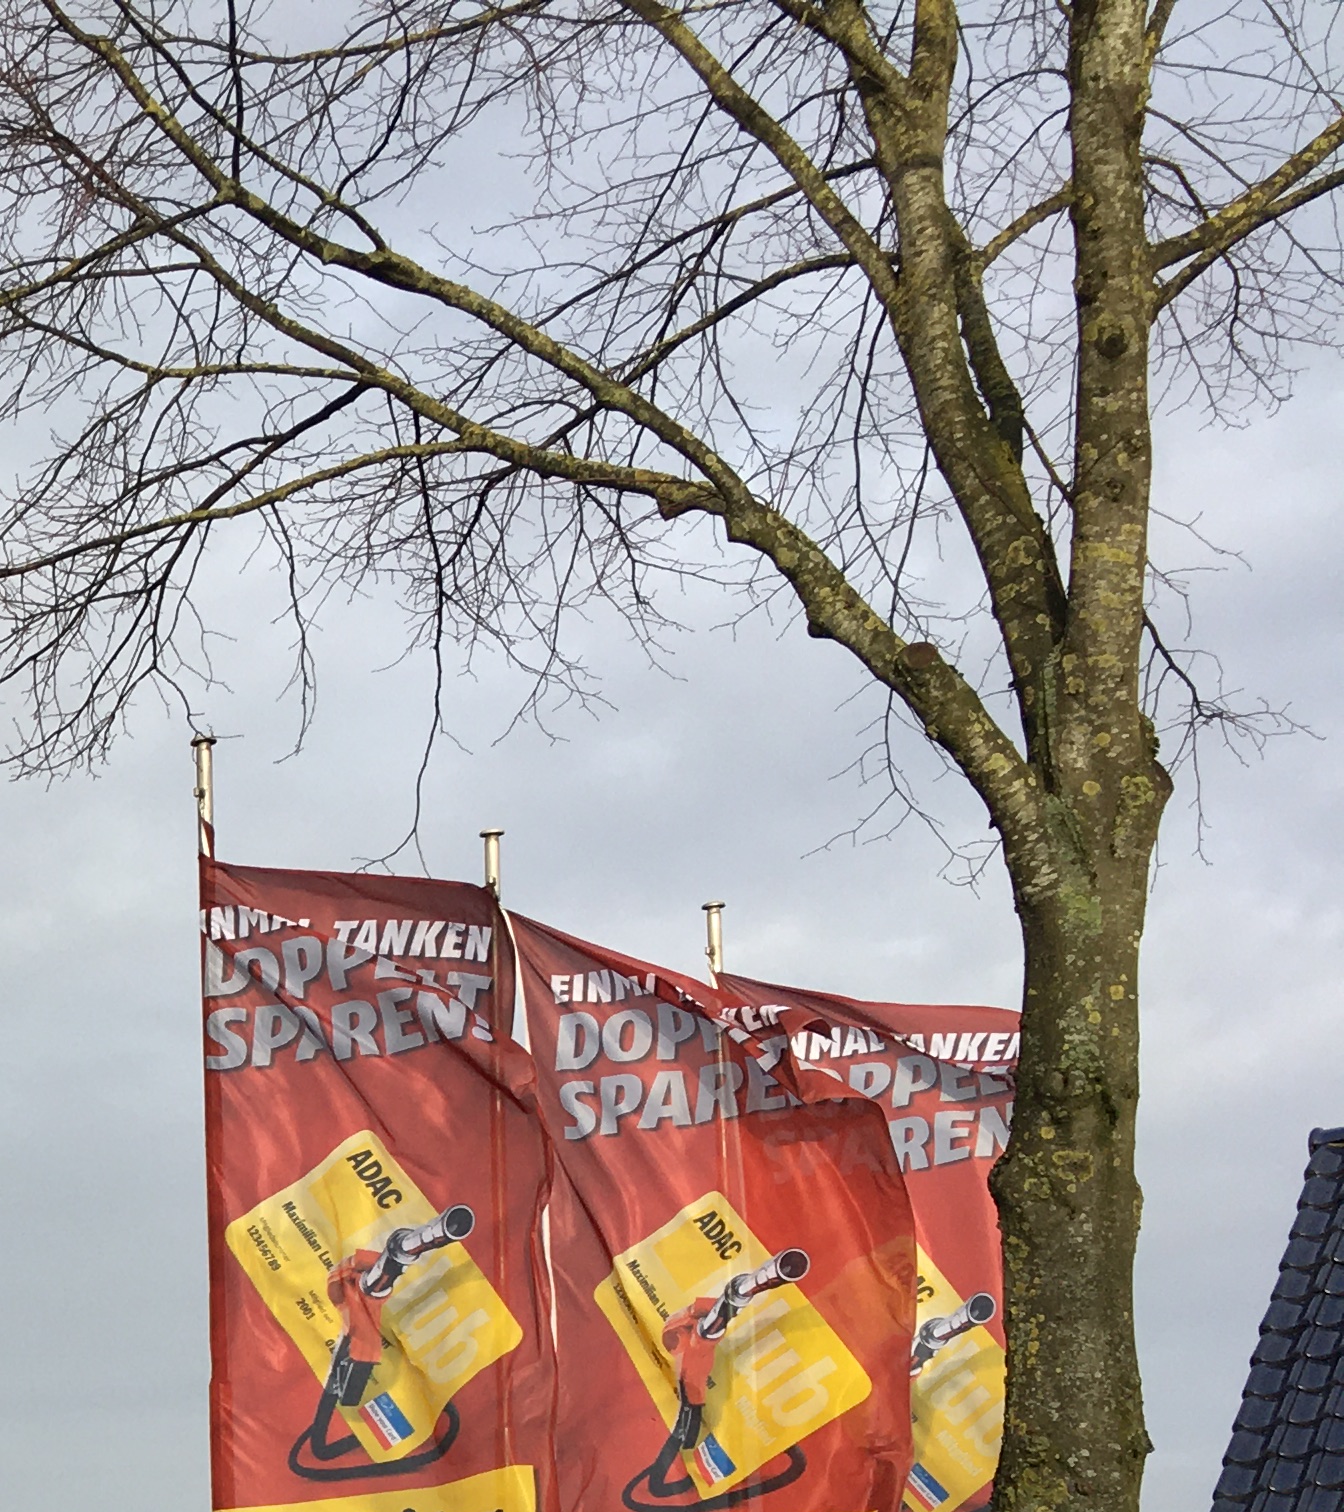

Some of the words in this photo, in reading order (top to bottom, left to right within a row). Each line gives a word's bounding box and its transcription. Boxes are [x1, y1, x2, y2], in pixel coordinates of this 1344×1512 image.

[330, 919, 492, 962] TANKEN
[560, 1060, 802, 1139] SPARE
[346, 1150, 402, 1210] ADAC
[246, 1224, 282, 1272] 123456789
[281, 1200, 323, 1253] Maximilian
[693, 1210, 743, 1260] ADAC
[625, 1258, 664, 1306] Maximilian
[295, 1297, 316, 1321] 2001
[382, 1256, 490, 1384] lub
[727, 1298, 837, 1427] lub
